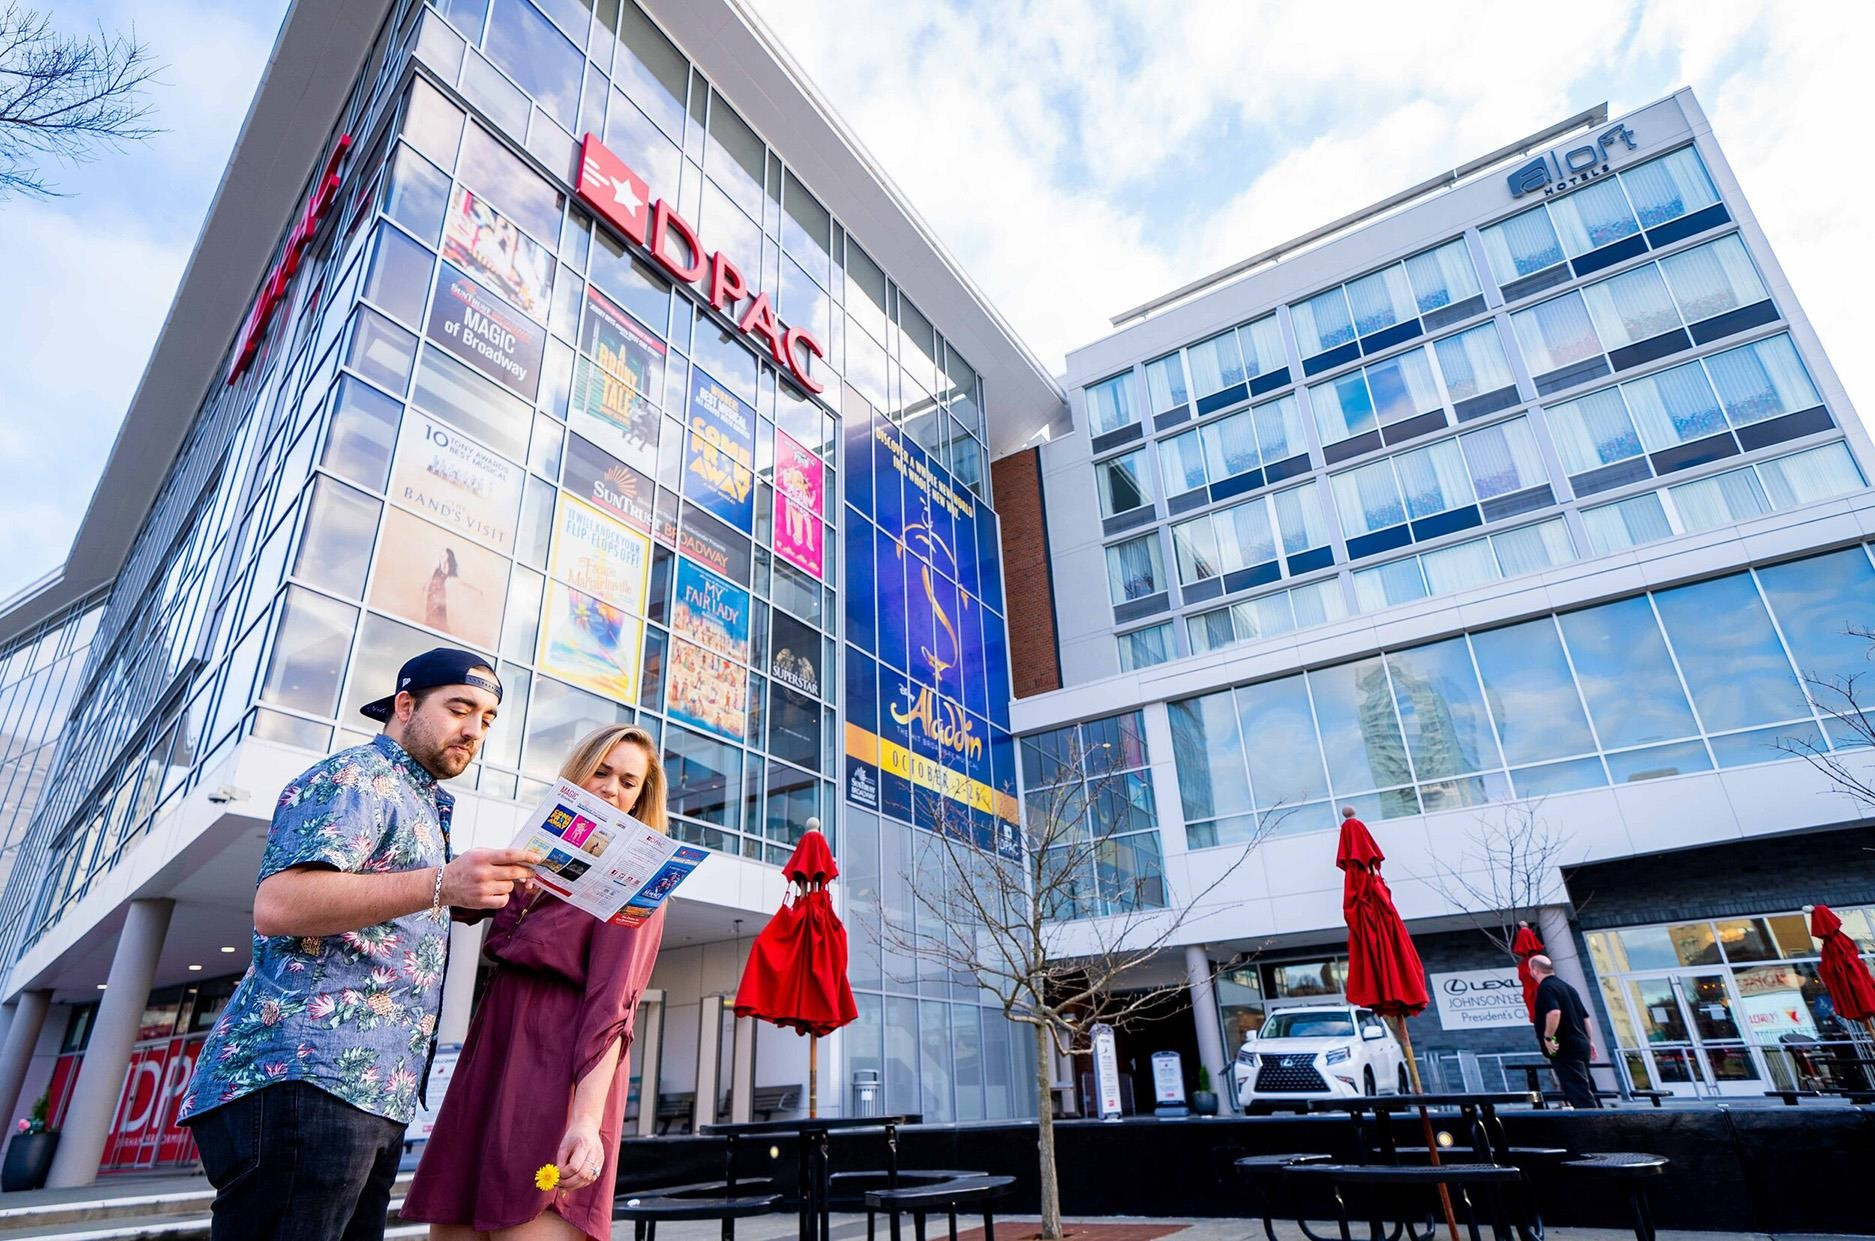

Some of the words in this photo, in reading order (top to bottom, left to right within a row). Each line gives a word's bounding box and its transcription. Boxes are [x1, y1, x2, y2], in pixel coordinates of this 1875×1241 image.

[1507, 123, 1637, 198] aloft
[1544, 164, 1610, 196] HOTELS
[650, 197, 824, 394] DPAC
[444, 320, 461, 338] of
[461, 328, 527, 381] Broadway
[463, 306, 516, 355] MAGIC
[426, 424, 449, 448] 10
[404, 486, 461, 522] BAND'S
[466, 515, 505, 543] VISIT
[663, 522, 729, 568] BROADWAY
[686, 584, 711, 612] FAIR
[713, 599, 739, 625] LADY
[705, 580, 725, 602] MY
[773, 664, 819, 696] SUPERSTAR
[890, 684, 983, 763] Aladdin
[892, 750, 949, 790] OCTOBER
[1448, 994, 1506, 1009] JOHNSON
[1470, 979, 1524, 991] LEXU
[1461, 1010, 1512, 1022] President's
